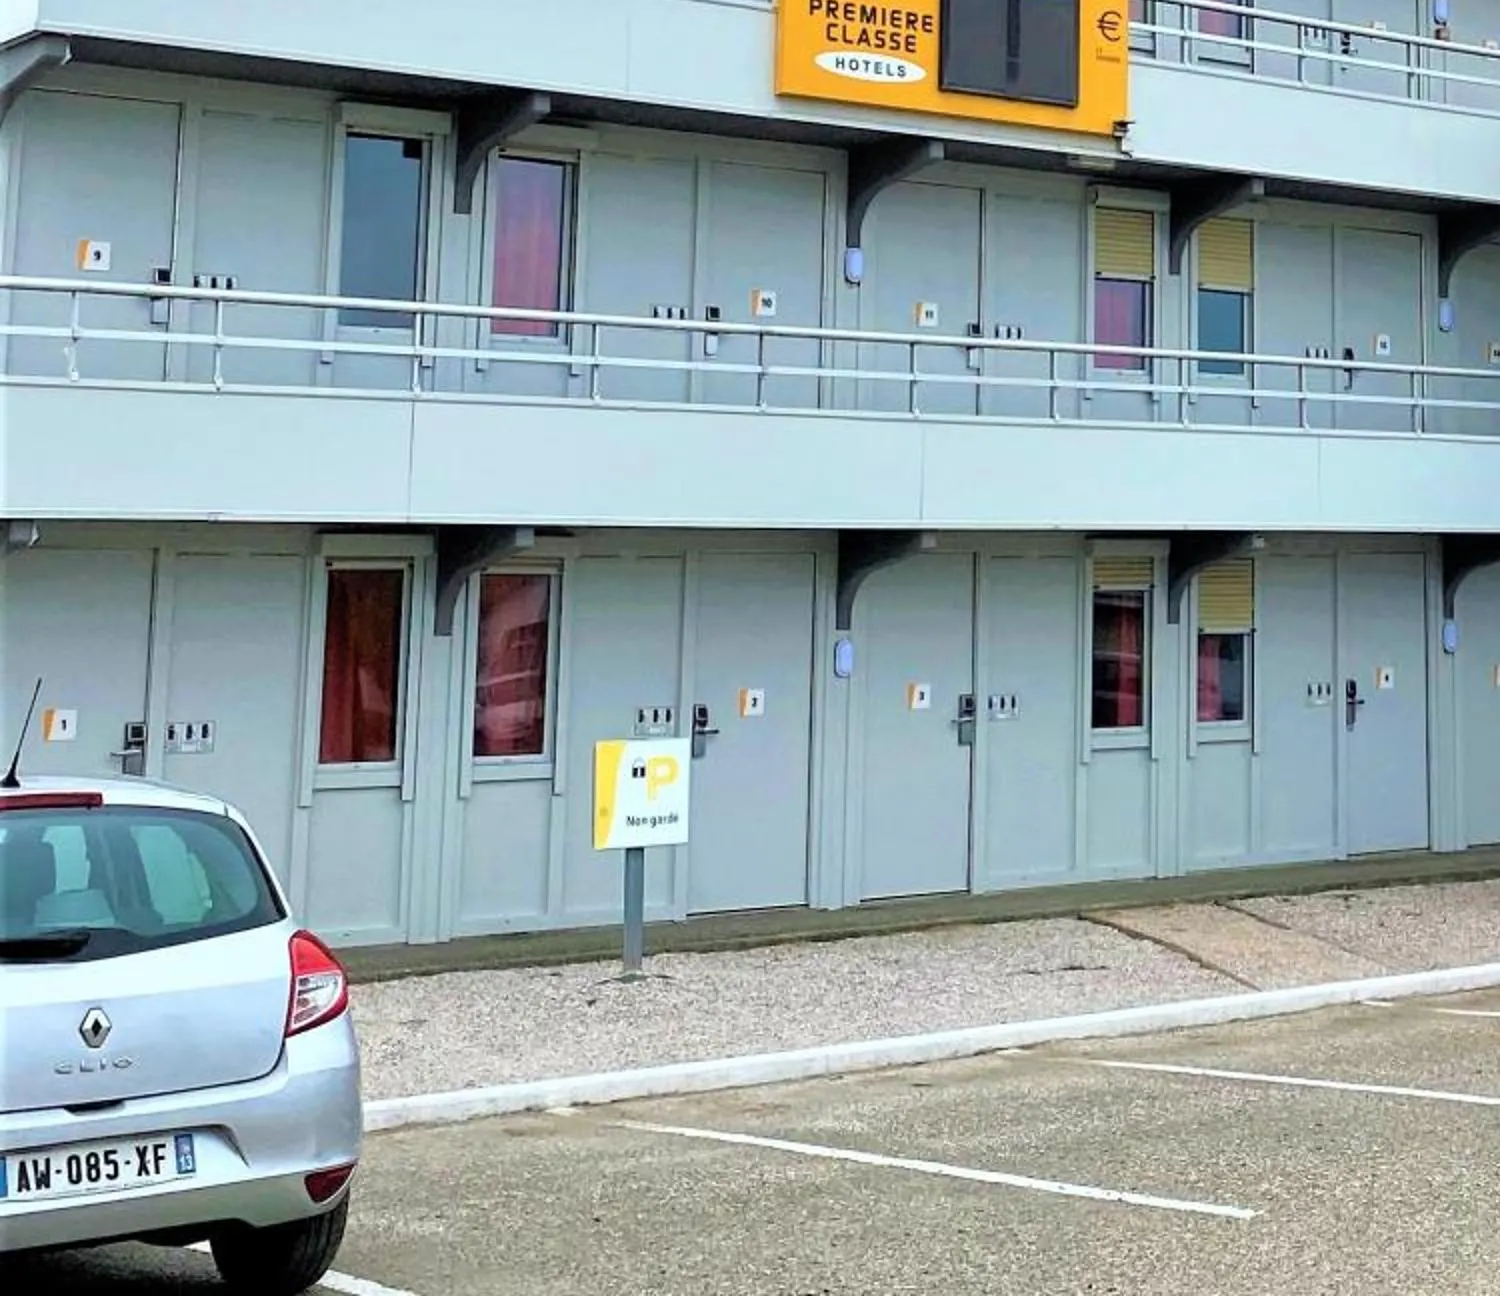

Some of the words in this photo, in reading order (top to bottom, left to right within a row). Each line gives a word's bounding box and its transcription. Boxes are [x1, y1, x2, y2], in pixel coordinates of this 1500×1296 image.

[825, 23, 917, 53] CLASSE
[1096, 10, 1122, 42] €
[835, 56, 907, 78] HOTELS
[647, 756, 679, 800] P
[54, 1056, 133, 1075] CLIO
[17, 1144, 167, 1193] AW-085-XF
